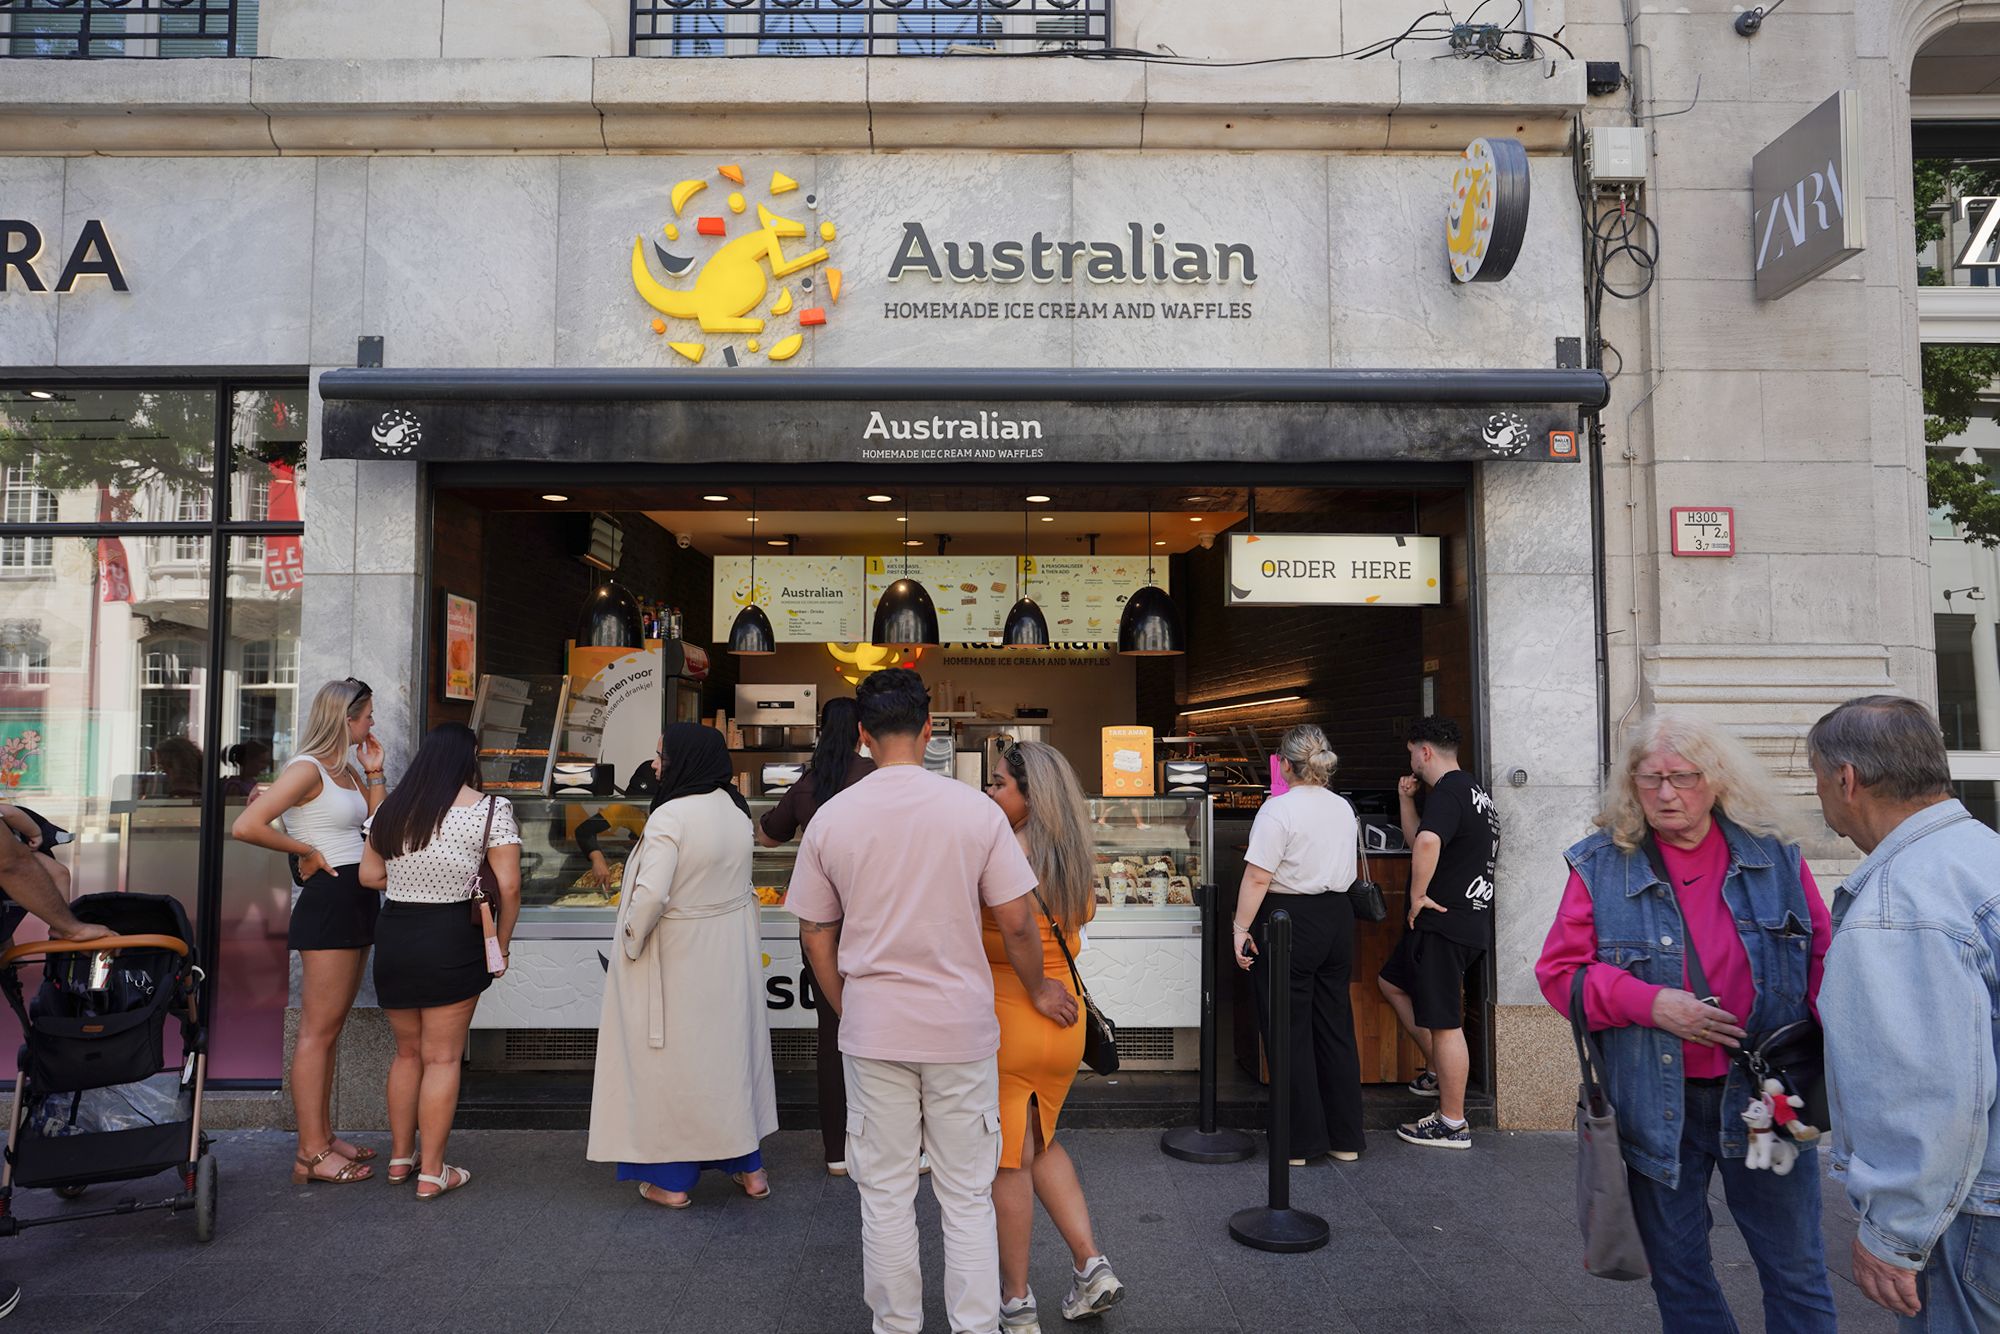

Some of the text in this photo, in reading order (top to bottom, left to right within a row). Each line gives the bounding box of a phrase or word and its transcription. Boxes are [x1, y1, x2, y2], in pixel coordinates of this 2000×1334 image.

[887, 222, 1259, 285] Australian
[884, 302, 1253, 320] HOMEMADE ICE CREAM AND WAFFLES
[862, 410, 1043, 440] Australian
[862, 449, 919, 459] HOMEMADE
[974, 448, 996, 458] AND
[997, 448, 1044, 458] WAFFLES
[1687, 511, 1718, 523] H300
[1261, 559, 1412, 580] ORDER HERE
[781, 587, 844, 598] Australian
[943, 657, 1111, 666] HOMEMADE ICE CREAM AND WAFFLES
[627, 668, 653, 682] voor
